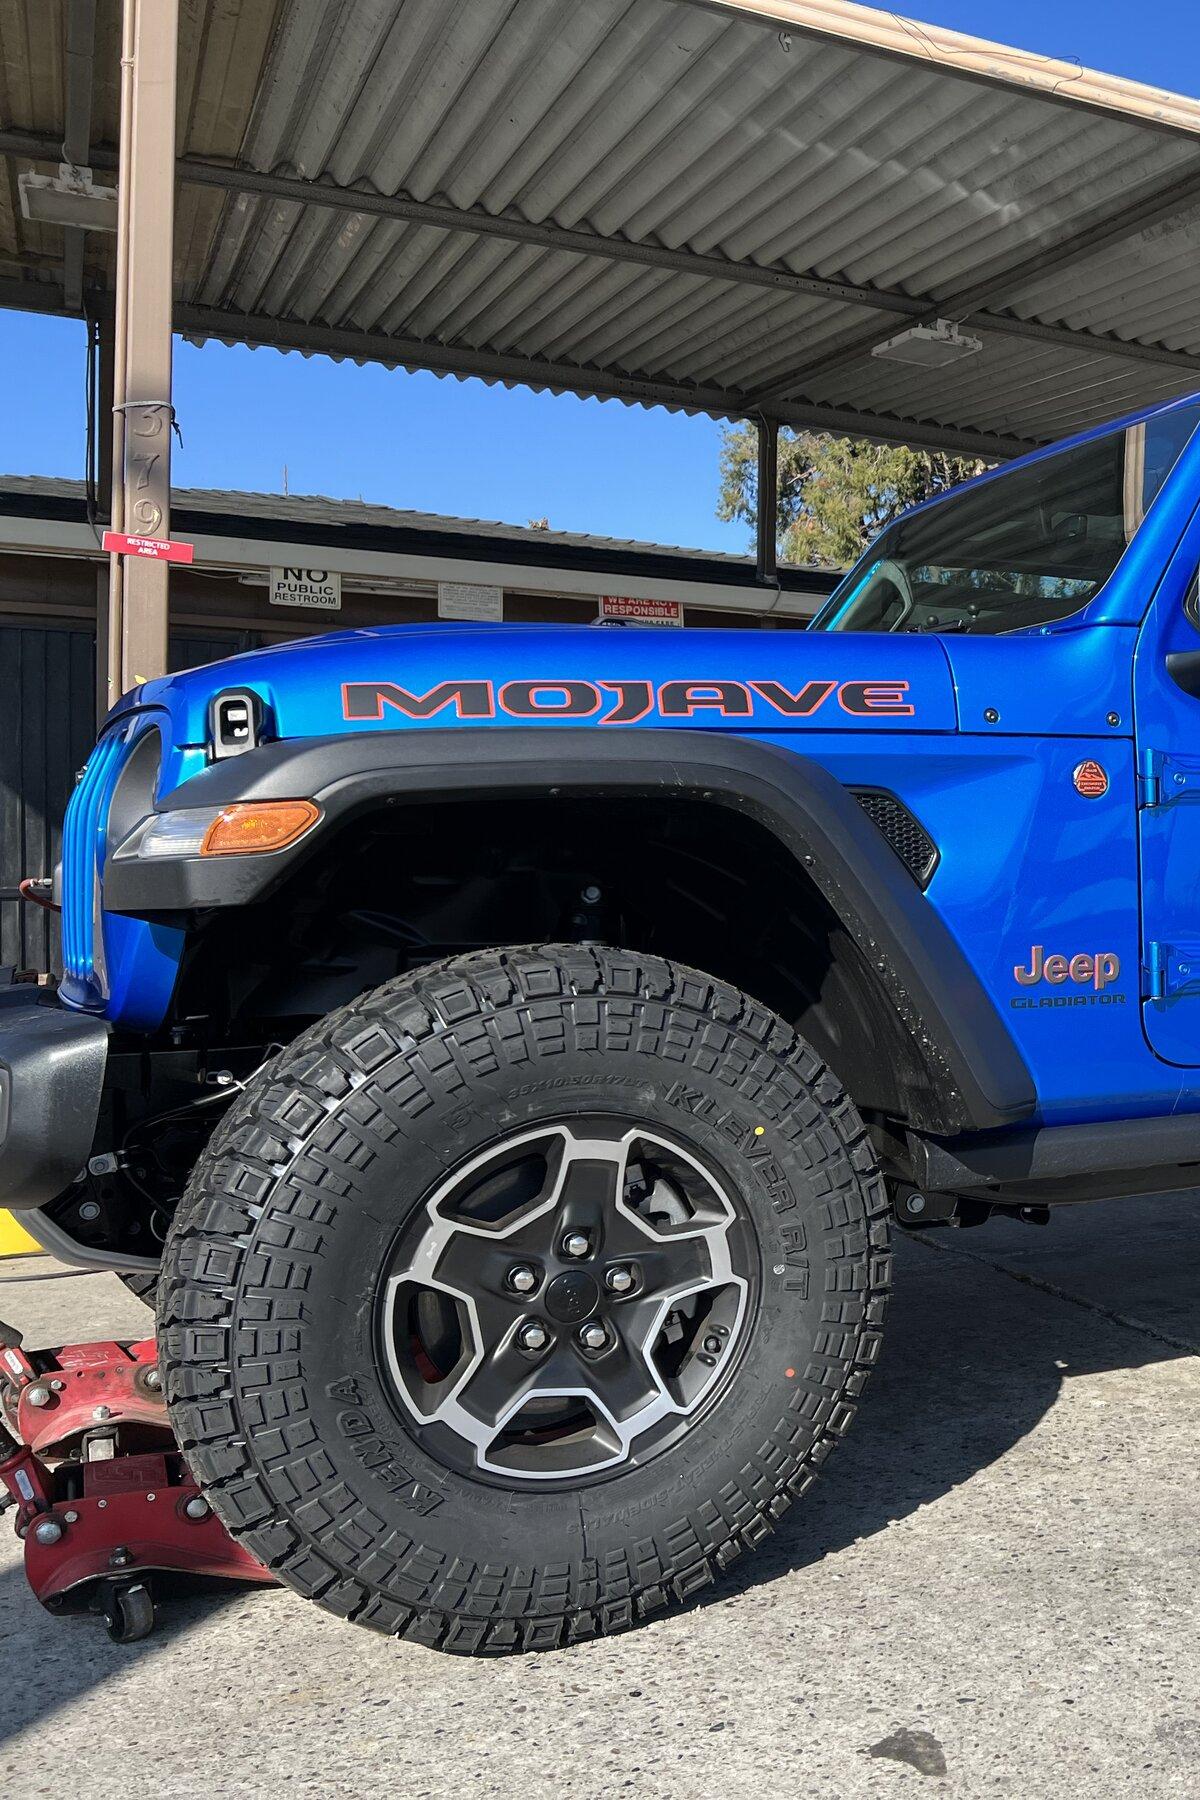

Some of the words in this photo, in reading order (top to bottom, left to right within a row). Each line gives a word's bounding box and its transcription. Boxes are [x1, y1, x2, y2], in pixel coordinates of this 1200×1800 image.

[133, 405, 163, 536] 379
[127, 538, 170, 550] RESTRICTED
[138, 547, 158, 556] AREA
[283, 568, 328, 583] NO
[277, 582, 333, 596] PUBLIC
[274, 592, 336, 605] RESTROOM
[604, 604, 678, 617] RESPONSIBLE
[341, 680, 915, 725] MOJAVE
[1013, 945, 1120, 990] Jeep
[1010, 994, 1127, 1009] GLADIATOR
[664, 1080, 797, 1215] KLEVER
[779, 1221, 810, 1300] R/T
[325, 1372, 446, 1518] KENDA
